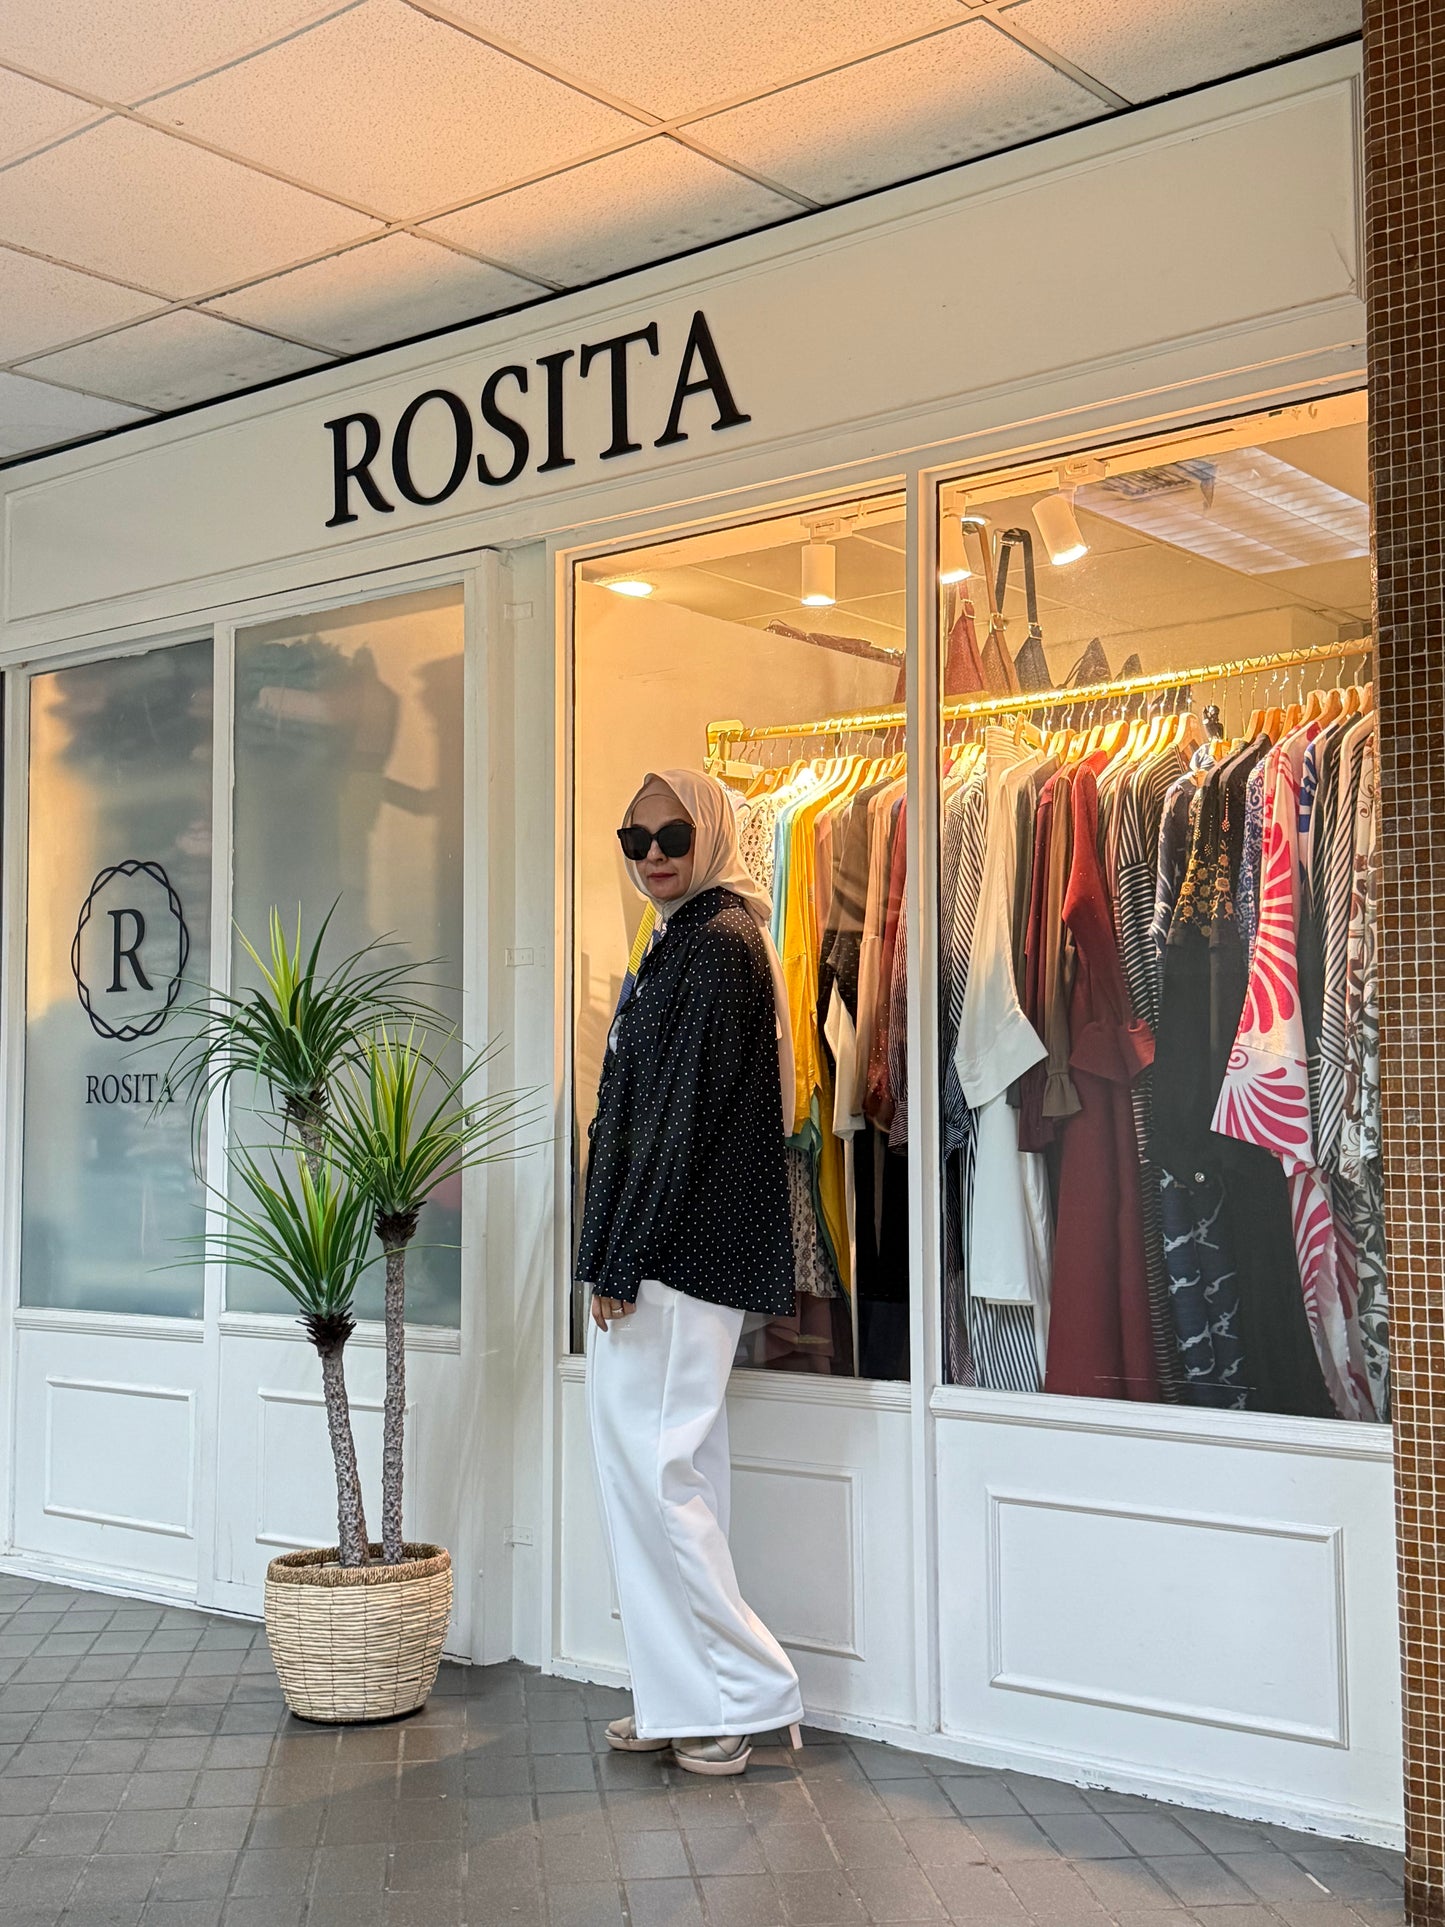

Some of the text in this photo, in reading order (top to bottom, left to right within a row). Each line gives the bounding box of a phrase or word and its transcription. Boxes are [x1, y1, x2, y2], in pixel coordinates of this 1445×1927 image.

[324, 310, 751, 527] ROSITA
[105, 908, 154, 993] R
[85, 1073, 175, 1104] ROSITA
